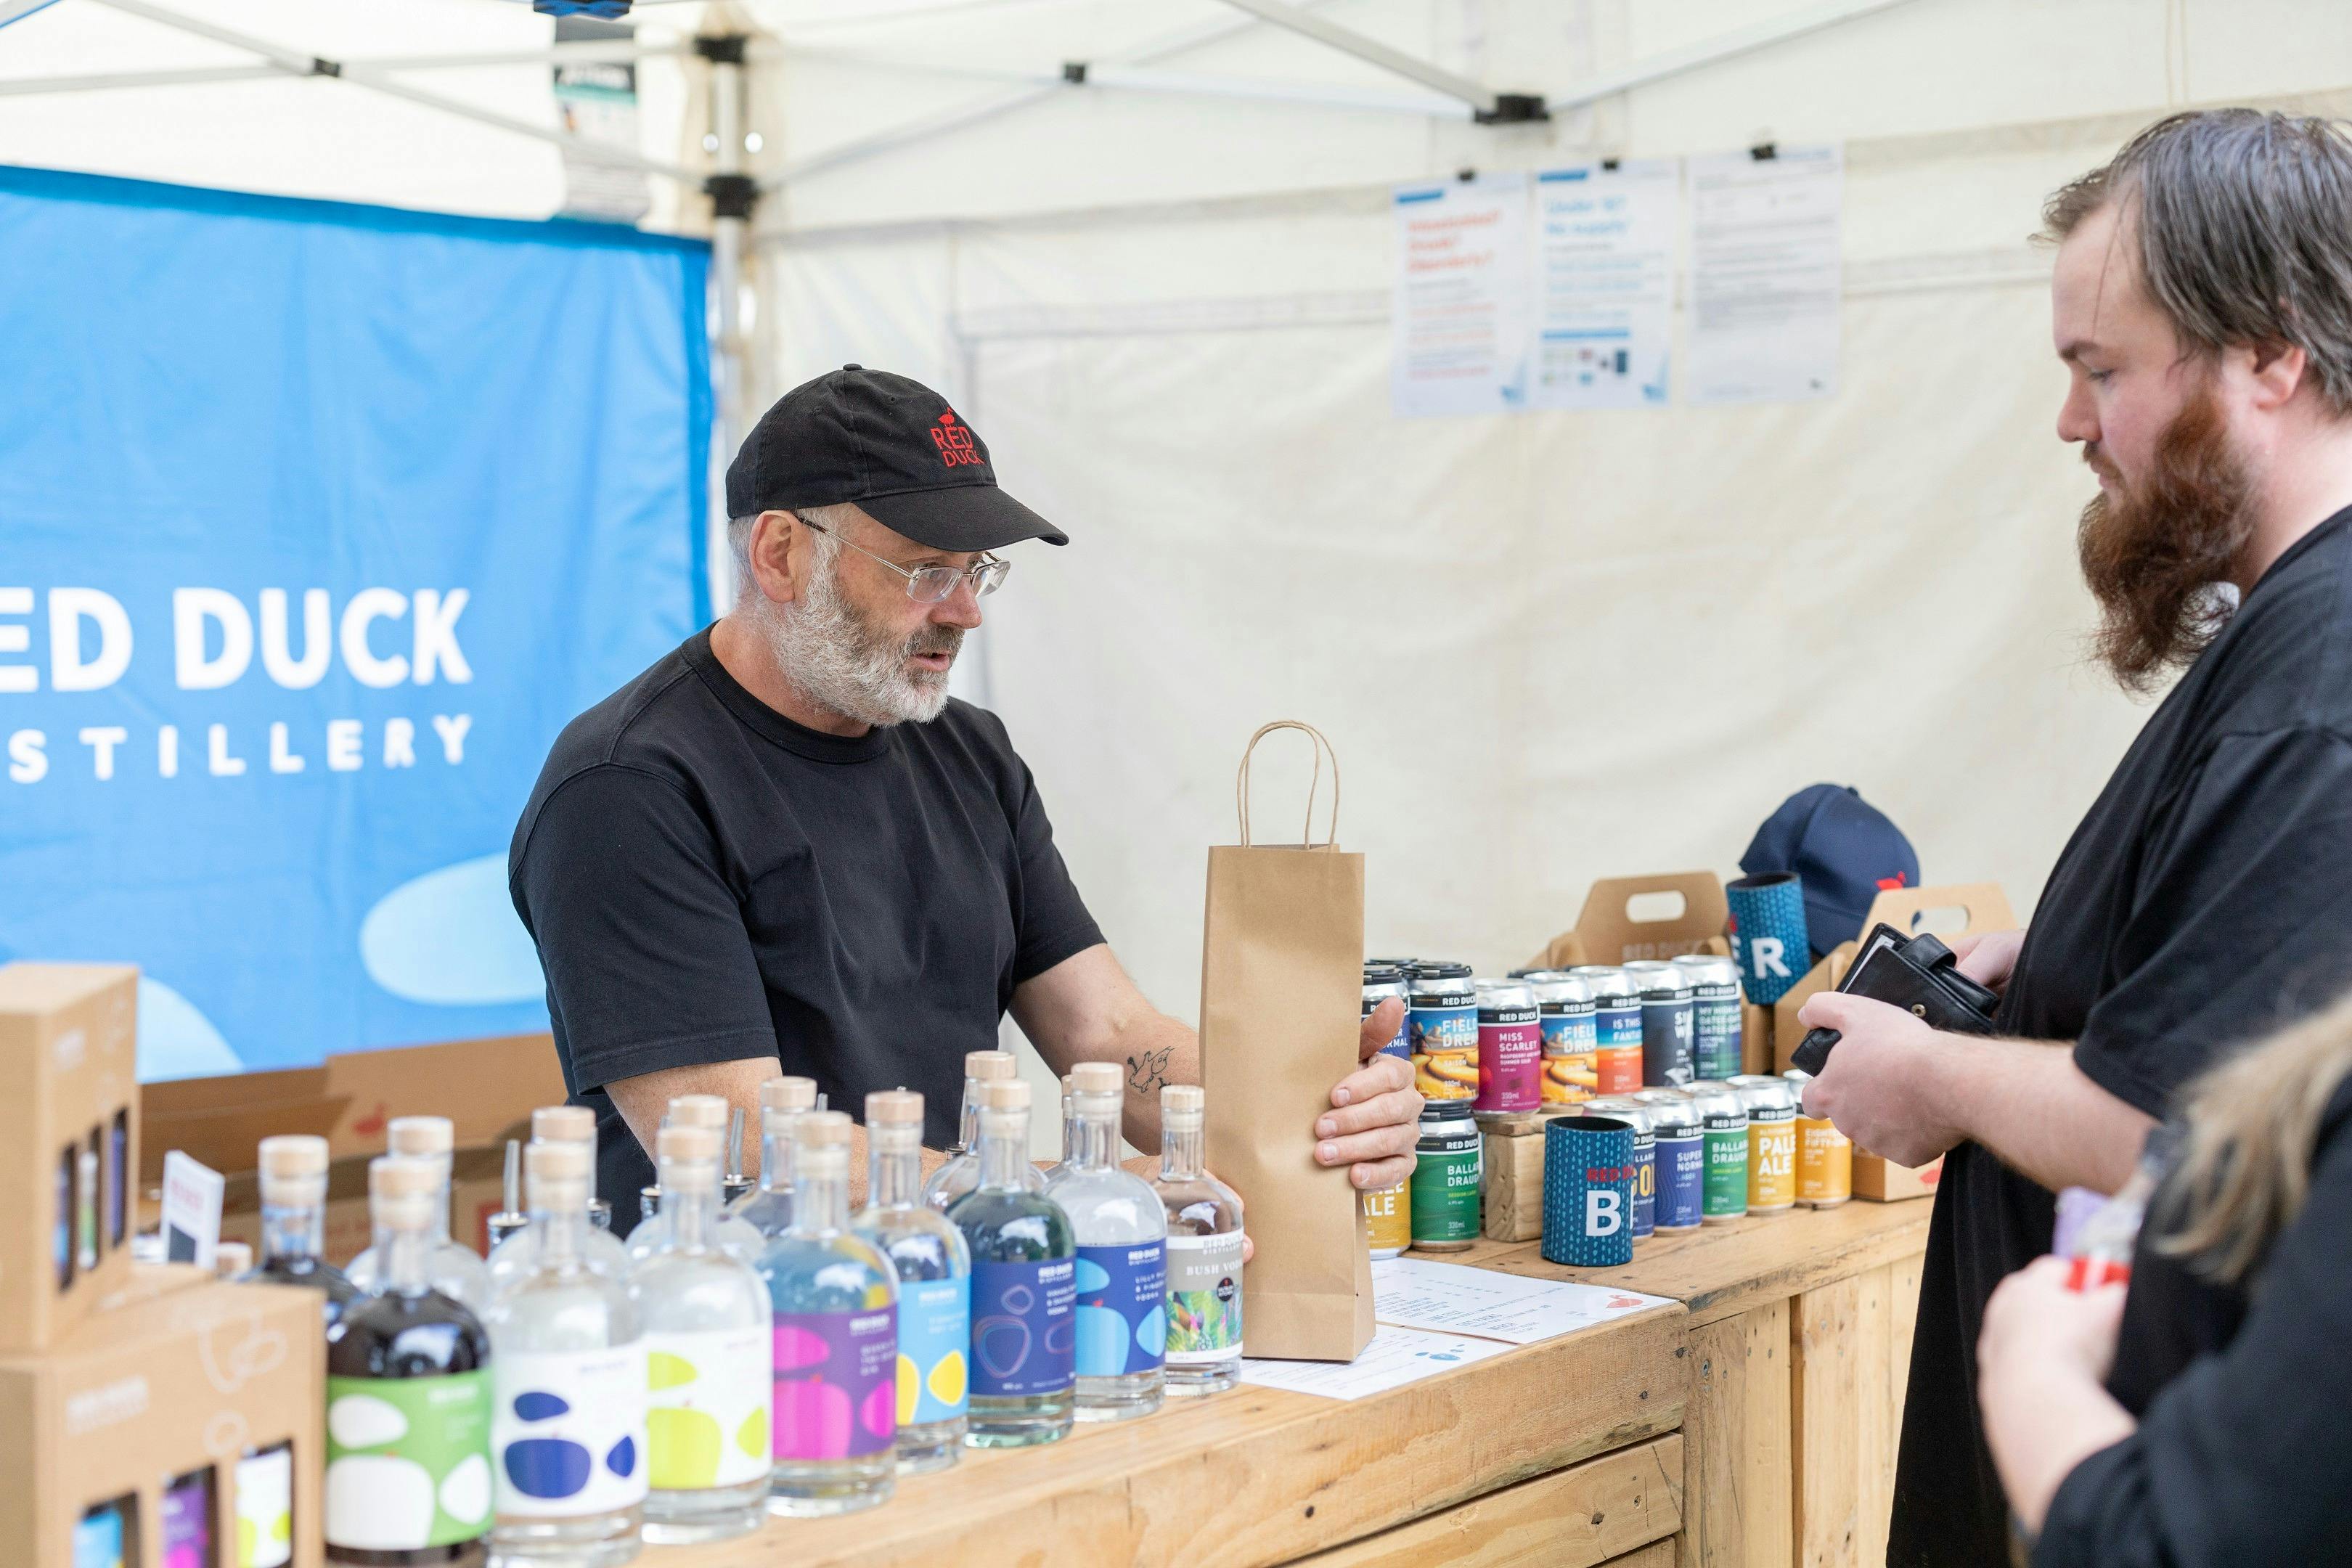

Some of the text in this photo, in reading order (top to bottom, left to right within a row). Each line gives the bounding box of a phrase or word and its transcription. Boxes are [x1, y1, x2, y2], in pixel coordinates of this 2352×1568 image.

[930, 426, 973, 450] RED
[942, 449, 985, 467] DUCK
[173, 586, 473, 690] DUCK
[8, 713, 473, 784] STILLERY
[1442, 997, 1460, 1006] RED
[1612, 999, 1628, 1008] RED
[1563, 1004, 1581, 1013] RED
[1499, 1011, 1537, 1022] RED DUCK
[1613, 1019, 1623, 1029] IS
[1499, 1032, 1523, 1042] MISS
[1499, 1040, 1538, 1053] SCARLET
[1758, 1111, 1776, 1120] RED
[1711, 1119, 1730, 1129] RED
[1676, 1127, 1693, 1138] RED
[1758, 1156, 1792, 1176] ALE
[1586, 1167, 1620, 1183] RED
[1185, 1265, 1220, 1276] BUSH
